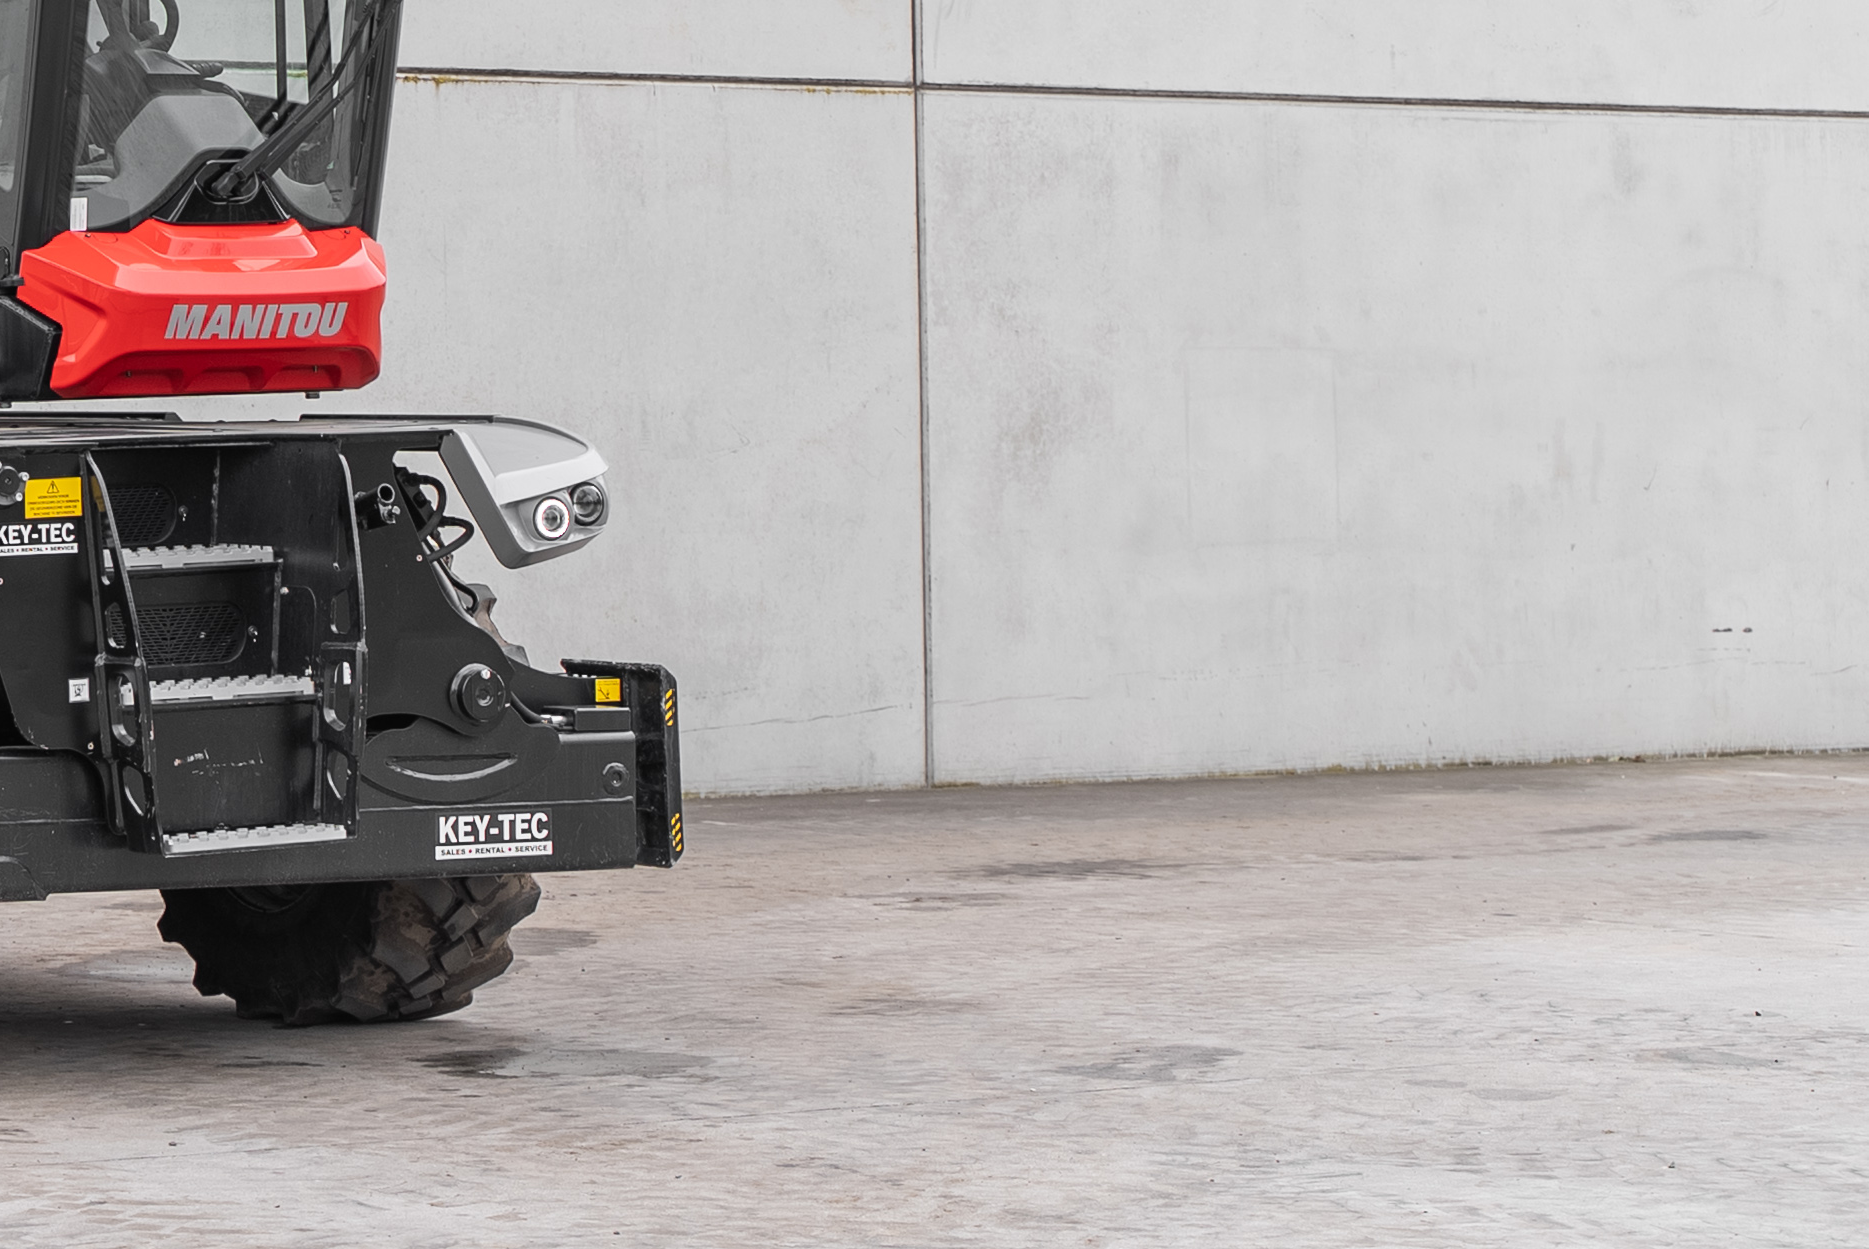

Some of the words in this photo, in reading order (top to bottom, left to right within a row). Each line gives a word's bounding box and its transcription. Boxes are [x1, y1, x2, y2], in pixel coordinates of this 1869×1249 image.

[164, 302, 348, 339] MANITOU
[439, 812, 549, 843] KEY-TEC
[514, 844, 548, 853] SERVICE
